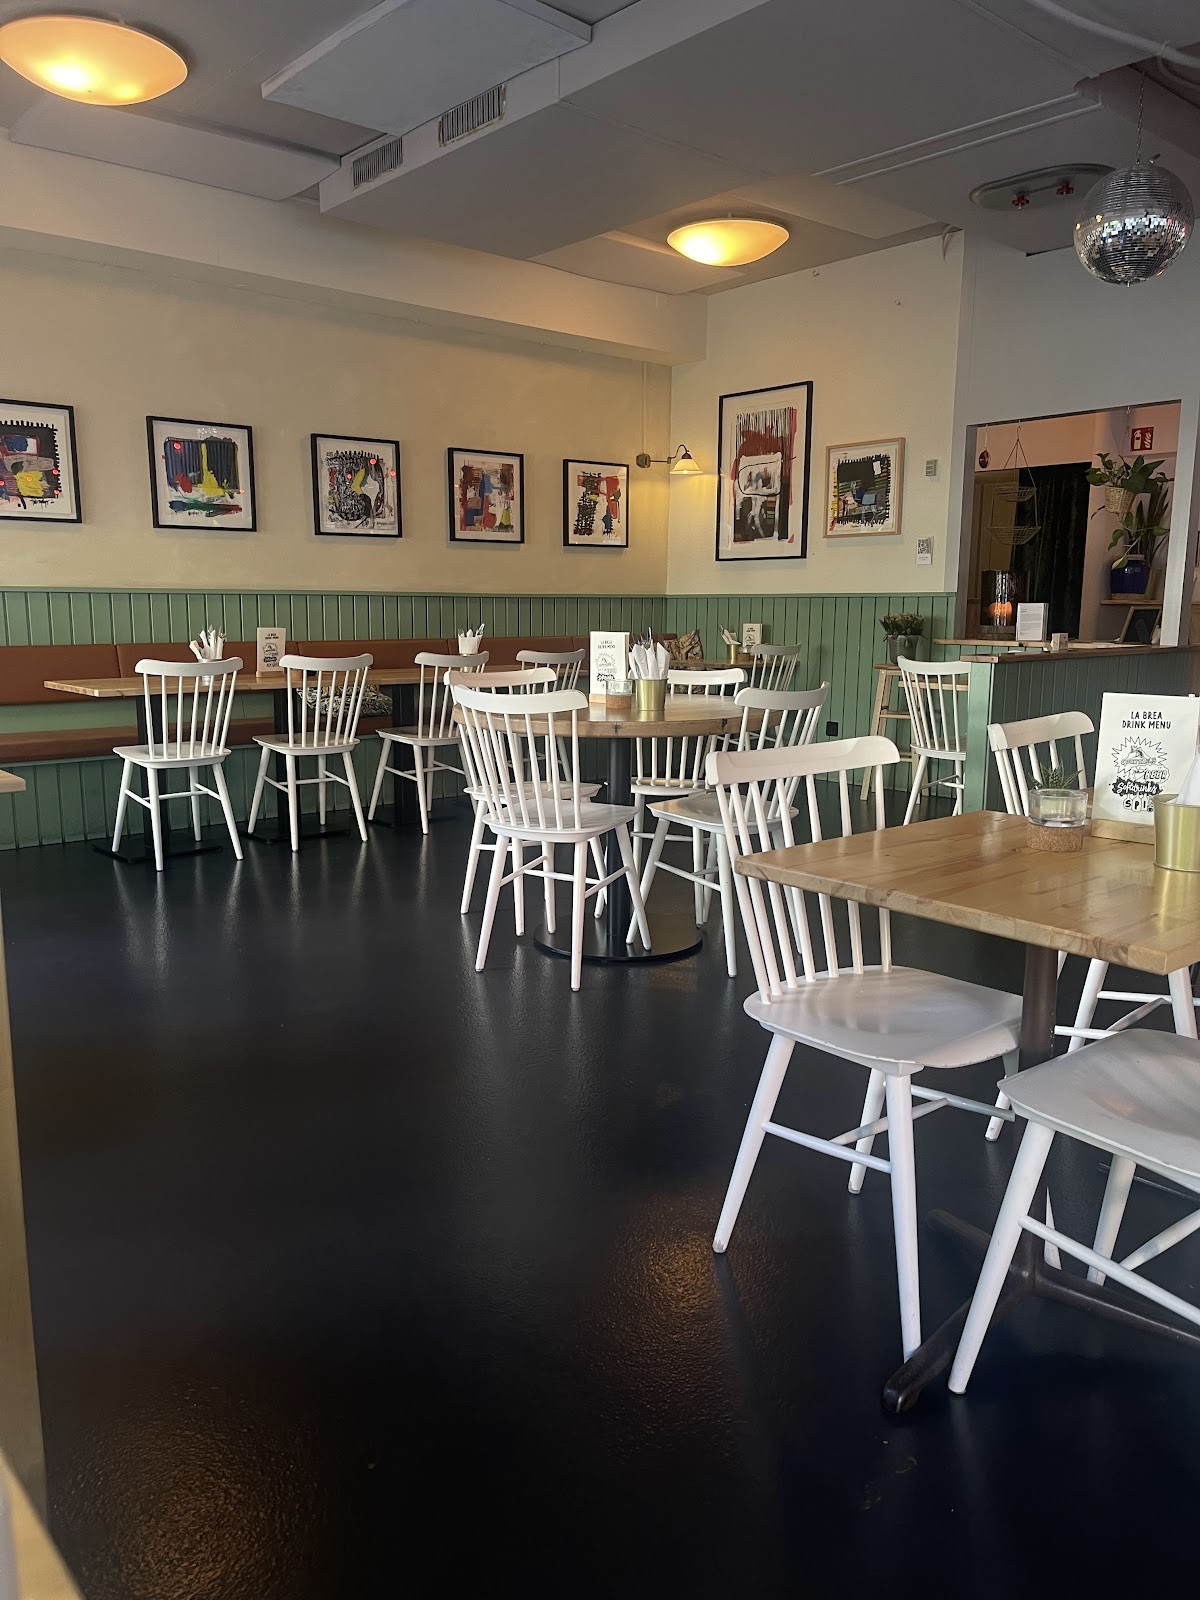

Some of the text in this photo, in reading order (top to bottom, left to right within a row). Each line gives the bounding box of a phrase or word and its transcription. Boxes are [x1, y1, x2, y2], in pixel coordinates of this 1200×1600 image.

[1131, 711, 1162, 720] LA BREA
[1122, 720, 1171, 730] DRINK MENU
[1125, 799, 1152, 811] SPI
